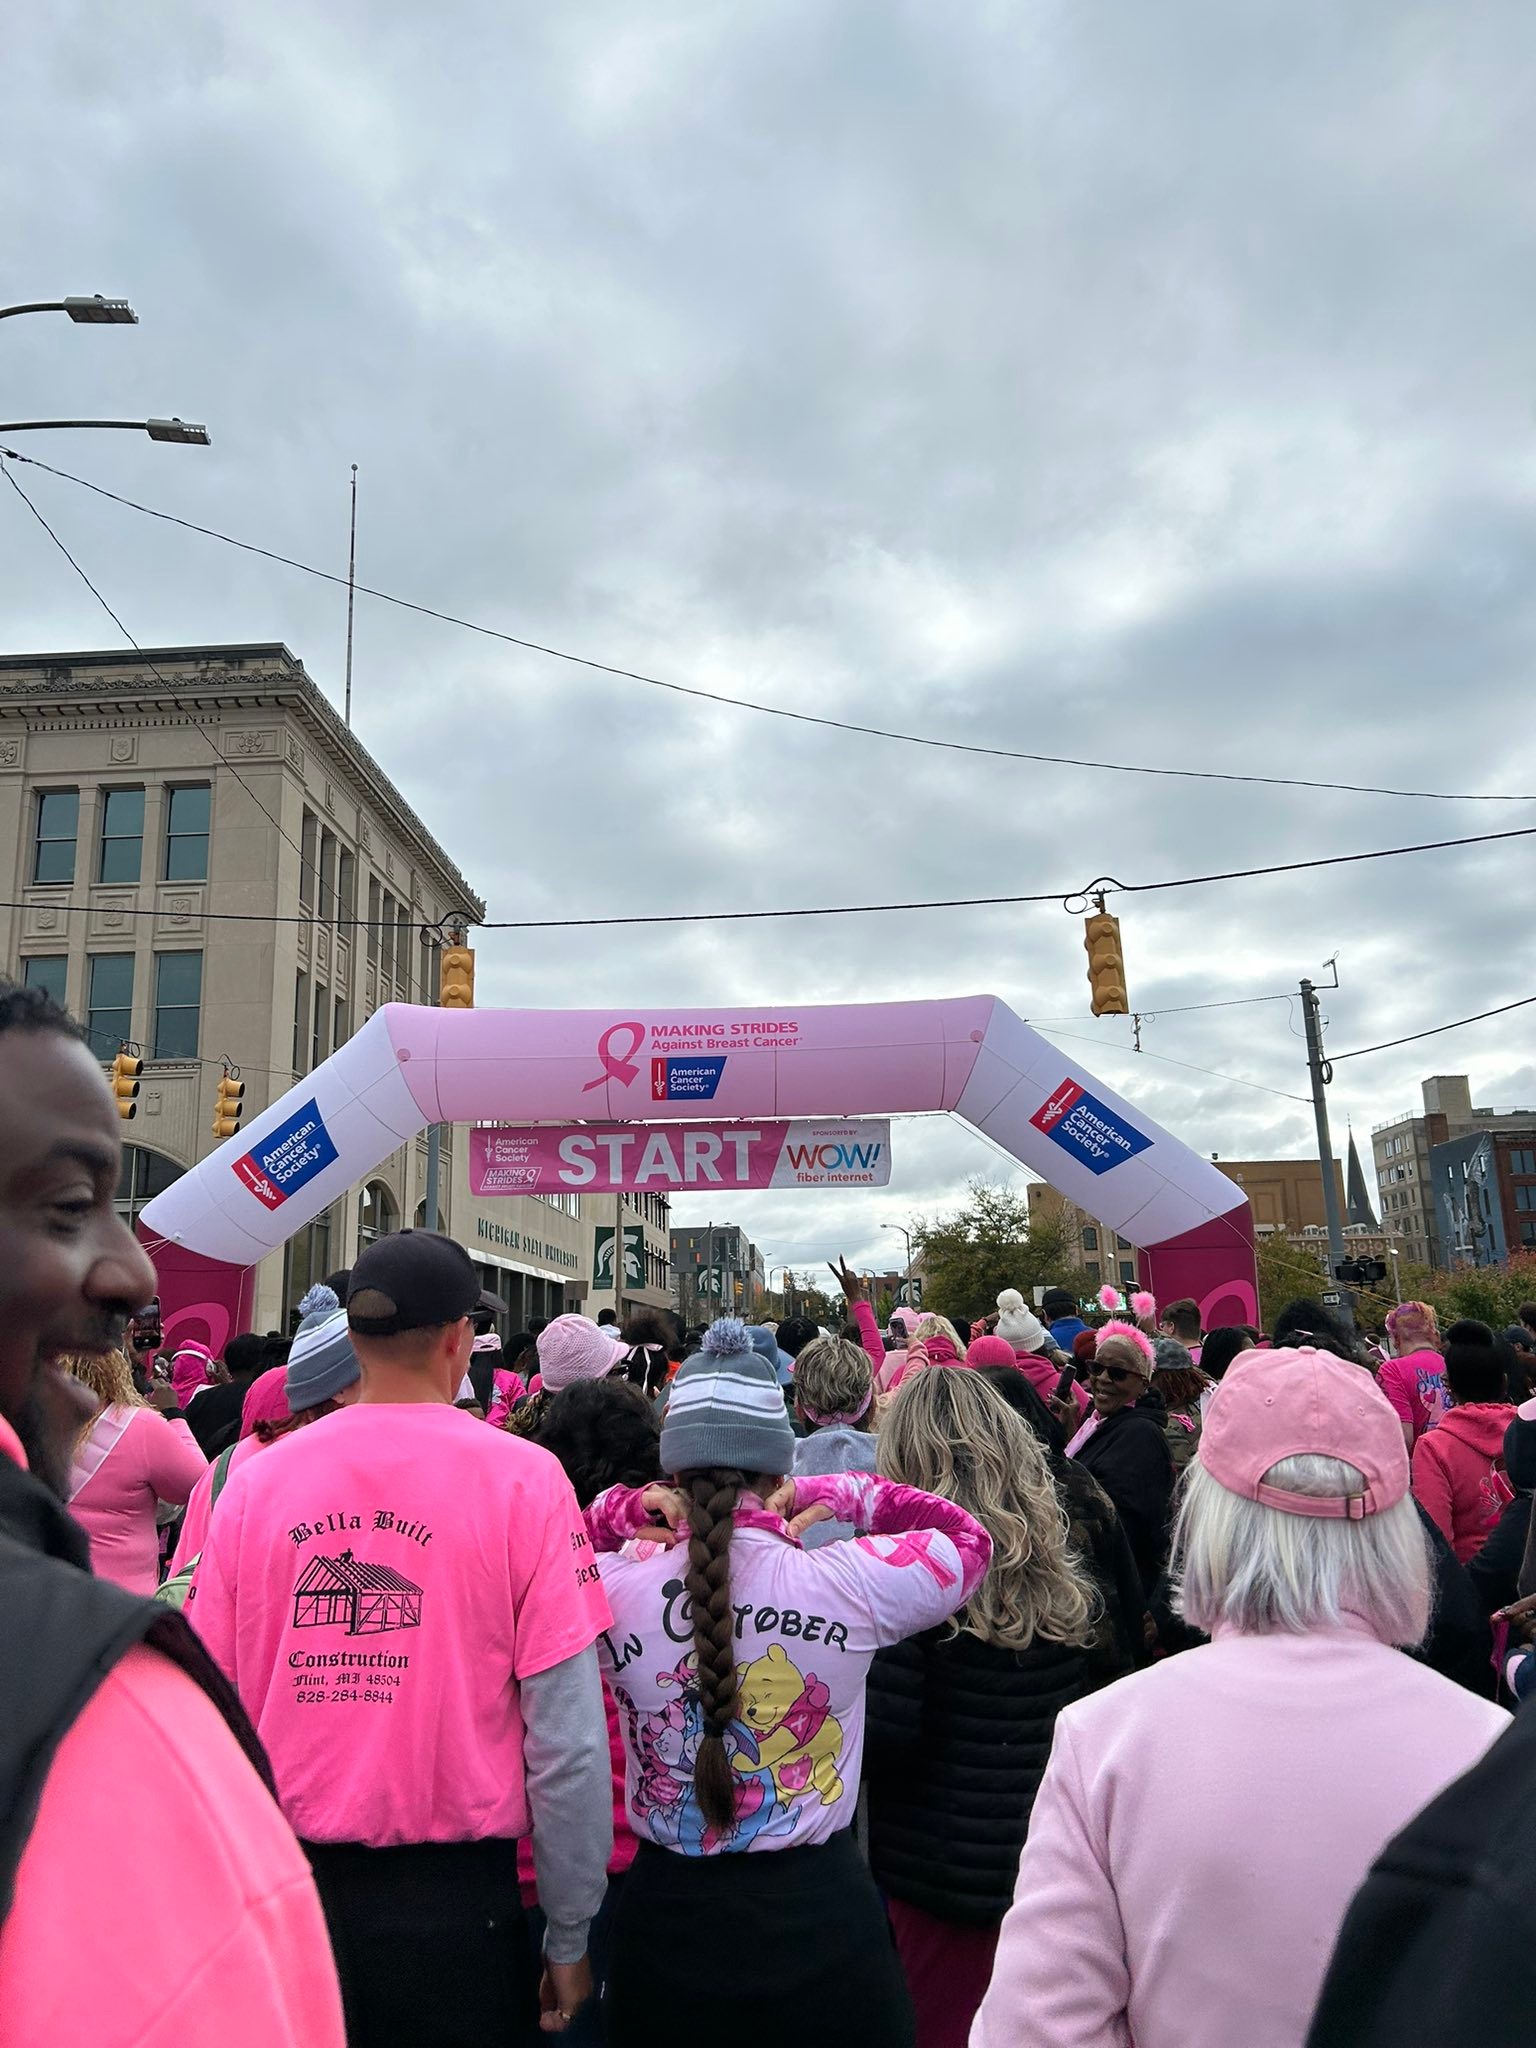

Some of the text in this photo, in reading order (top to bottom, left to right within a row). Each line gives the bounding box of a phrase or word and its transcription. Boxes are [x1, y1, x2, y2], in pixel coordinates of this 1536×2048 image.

[651, 1022, 799, 1037] MAKING STRIDES
[651, 1039, 703, 1052] Against
[707, 1037, 749, 1049] Breast
[670, 1067, 716, 1076] American
[670, 1076, 703, 1084] Cancer
[1069, 1112, 1111, 1146] Cancer
[1076, 1105, 1131, 1150] American
[262, 1121, 316, 1167] American
[495, 1137, 539, 1146] American
[268, 1140, 308, 1175] Cancer
[495, 1146, 528, 1154] Cancer
[786, 1143, 881, 1170] WOW!
[495, 1154, 530, 1163] Society
[558, 1131, 761, 1185] START
[486, 1176, 523, 1185] STRIDES
[488, 1169, 526, 1177] MAKING
[797, 1172, 874, 1183] fiber internet
[478, 1217, 578, 1270] MICHIGAN STATE UNIVERSITY
[288, 1510, 433, 1549] Bella Built
[597, 1578, 848, 1673] In OTOBER
[288, 1651, 409, 1669] Construction
[292, 1673, 401, 1687] Flint, MI 48504
[296, 1690, 393, 1703] 828-284-8844
